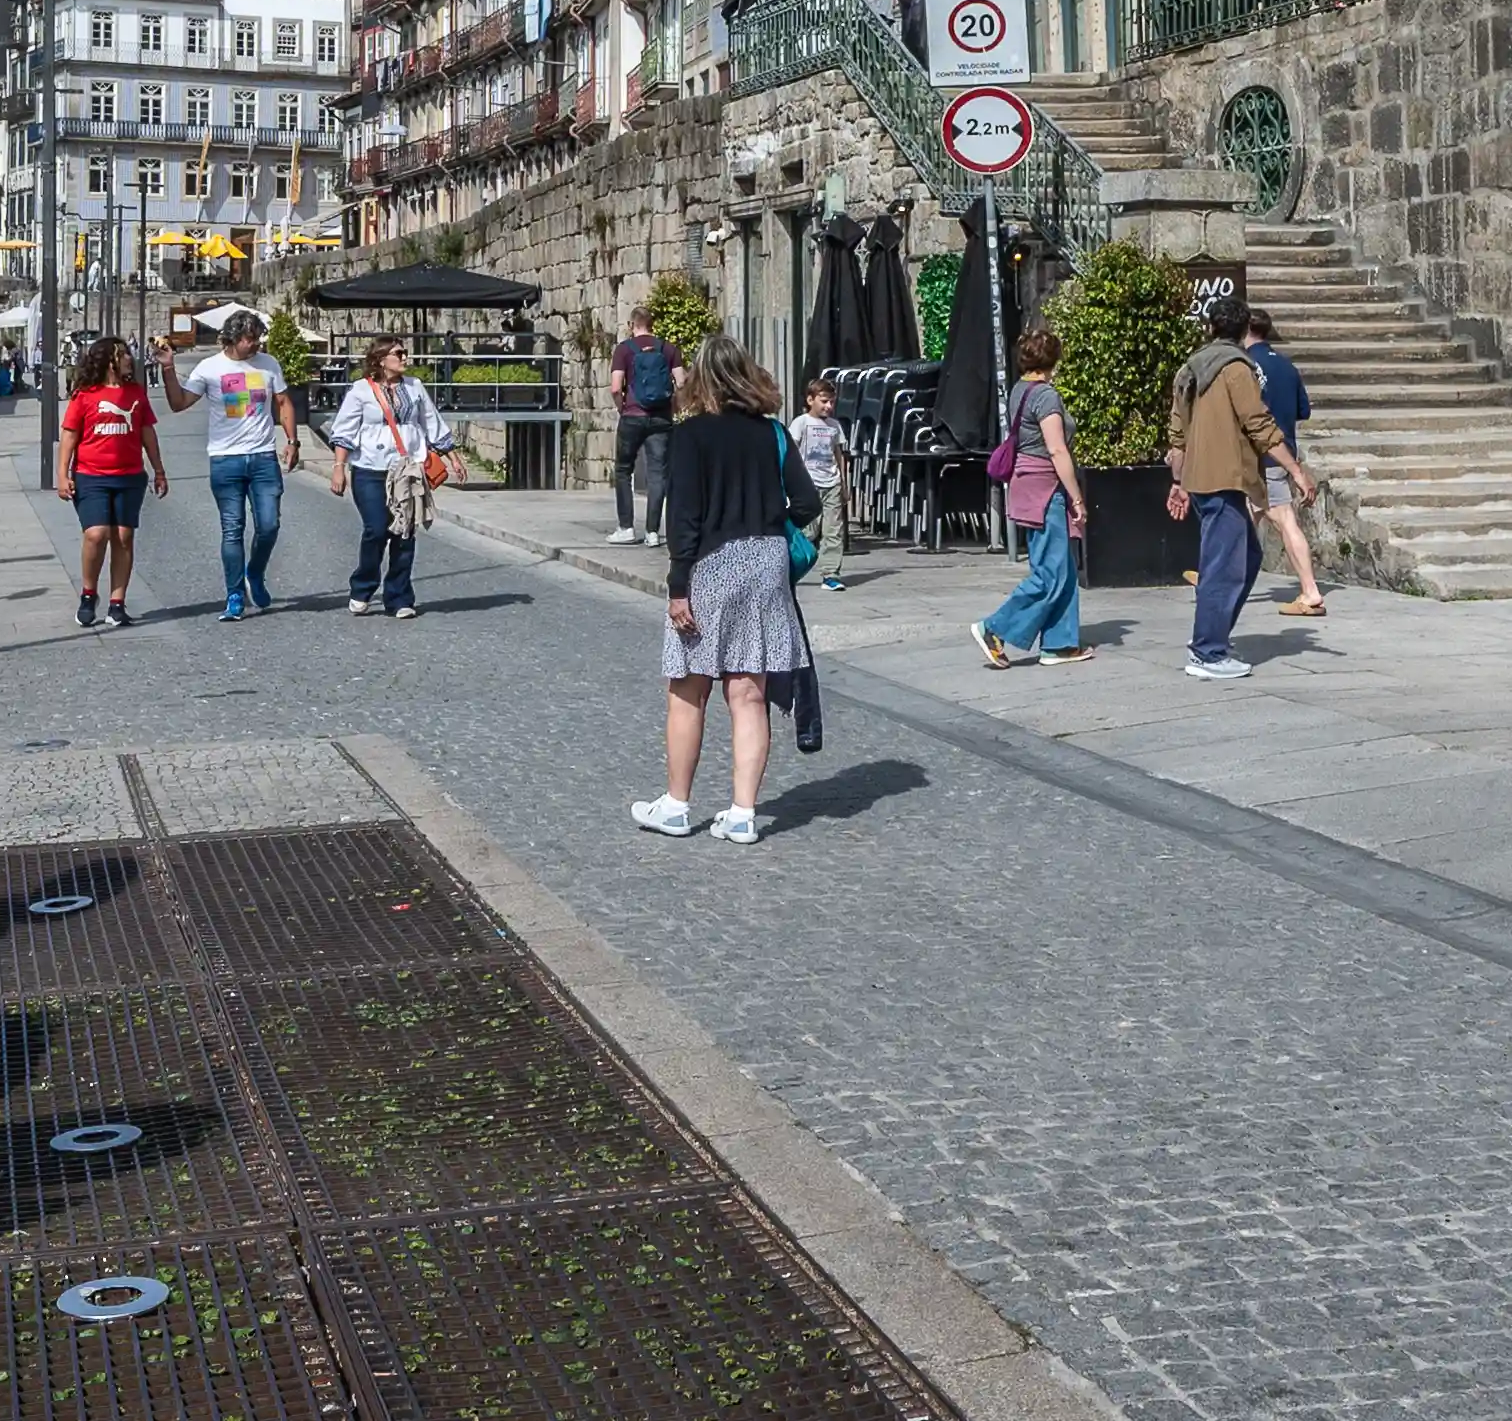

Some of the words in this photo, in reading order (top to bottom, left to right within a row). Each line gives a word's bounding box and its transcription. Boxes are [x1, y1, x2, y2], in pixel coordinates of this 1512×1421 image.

[960, 14, 995, 38] 20
[957, 61, 1001, 70] VELOCIDADE
[935, 70, 983, 78] CONTROLADA
[93, 422, 128, 435] PUMA
